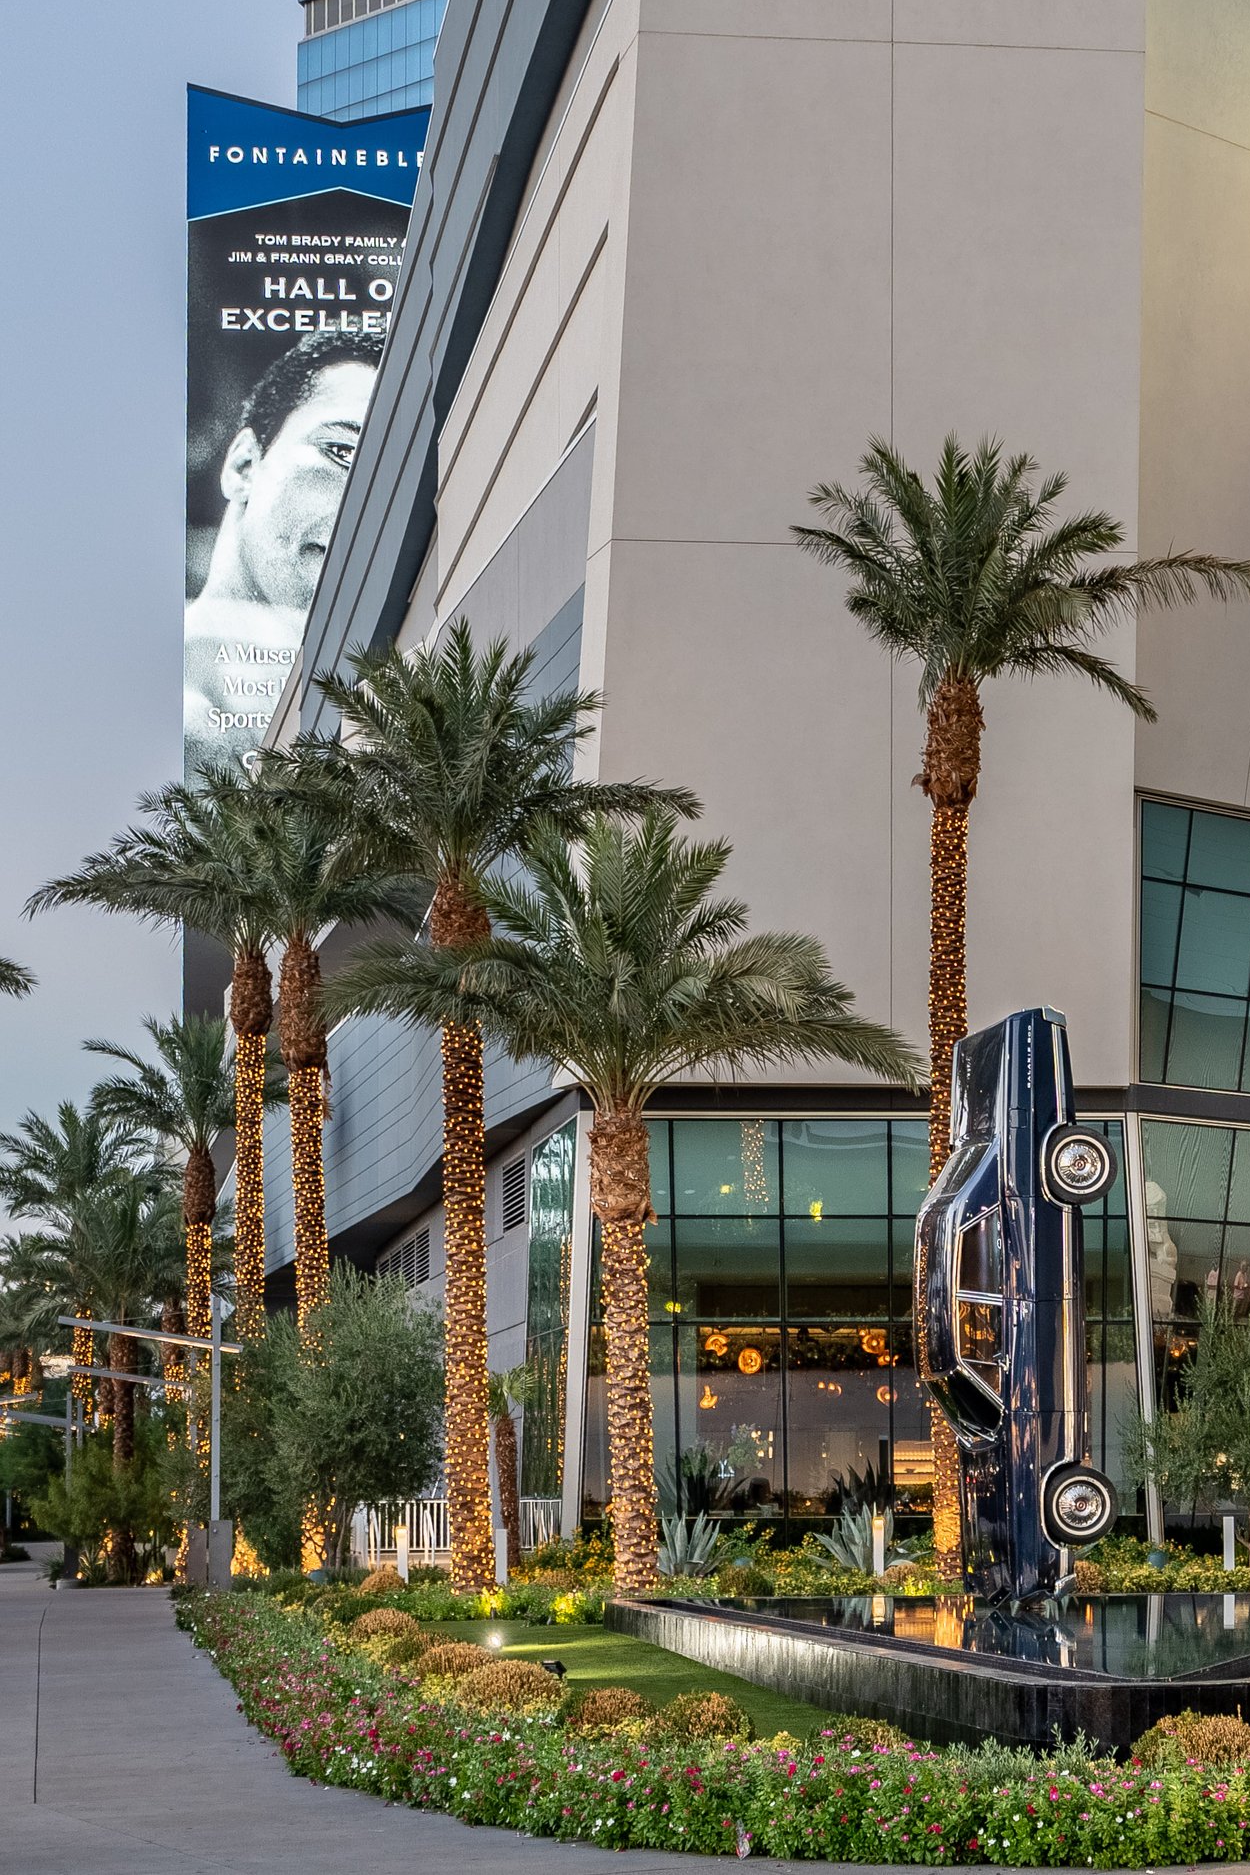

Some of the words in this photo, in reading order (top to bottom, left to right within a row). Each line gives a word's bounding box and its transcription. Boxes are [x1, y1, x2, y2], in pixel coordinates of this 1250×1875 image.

[255, 234, 287, 246] TOM
[291, 235, 341, 247] BRADY
[345, 236, 397, 248] FAMILY
[228, 251, 252, 263] JIM
[255, 252, 267, 263] &
[270, 253, 320, 264] FRANN
[324, 254, 364, 265] GRAY
[263, 276, 357, 301] HALL
[221, 307, 392, 333] EXCELLE
[214, 645, 230, 664] A
[223, 676, 275, 696] Most
